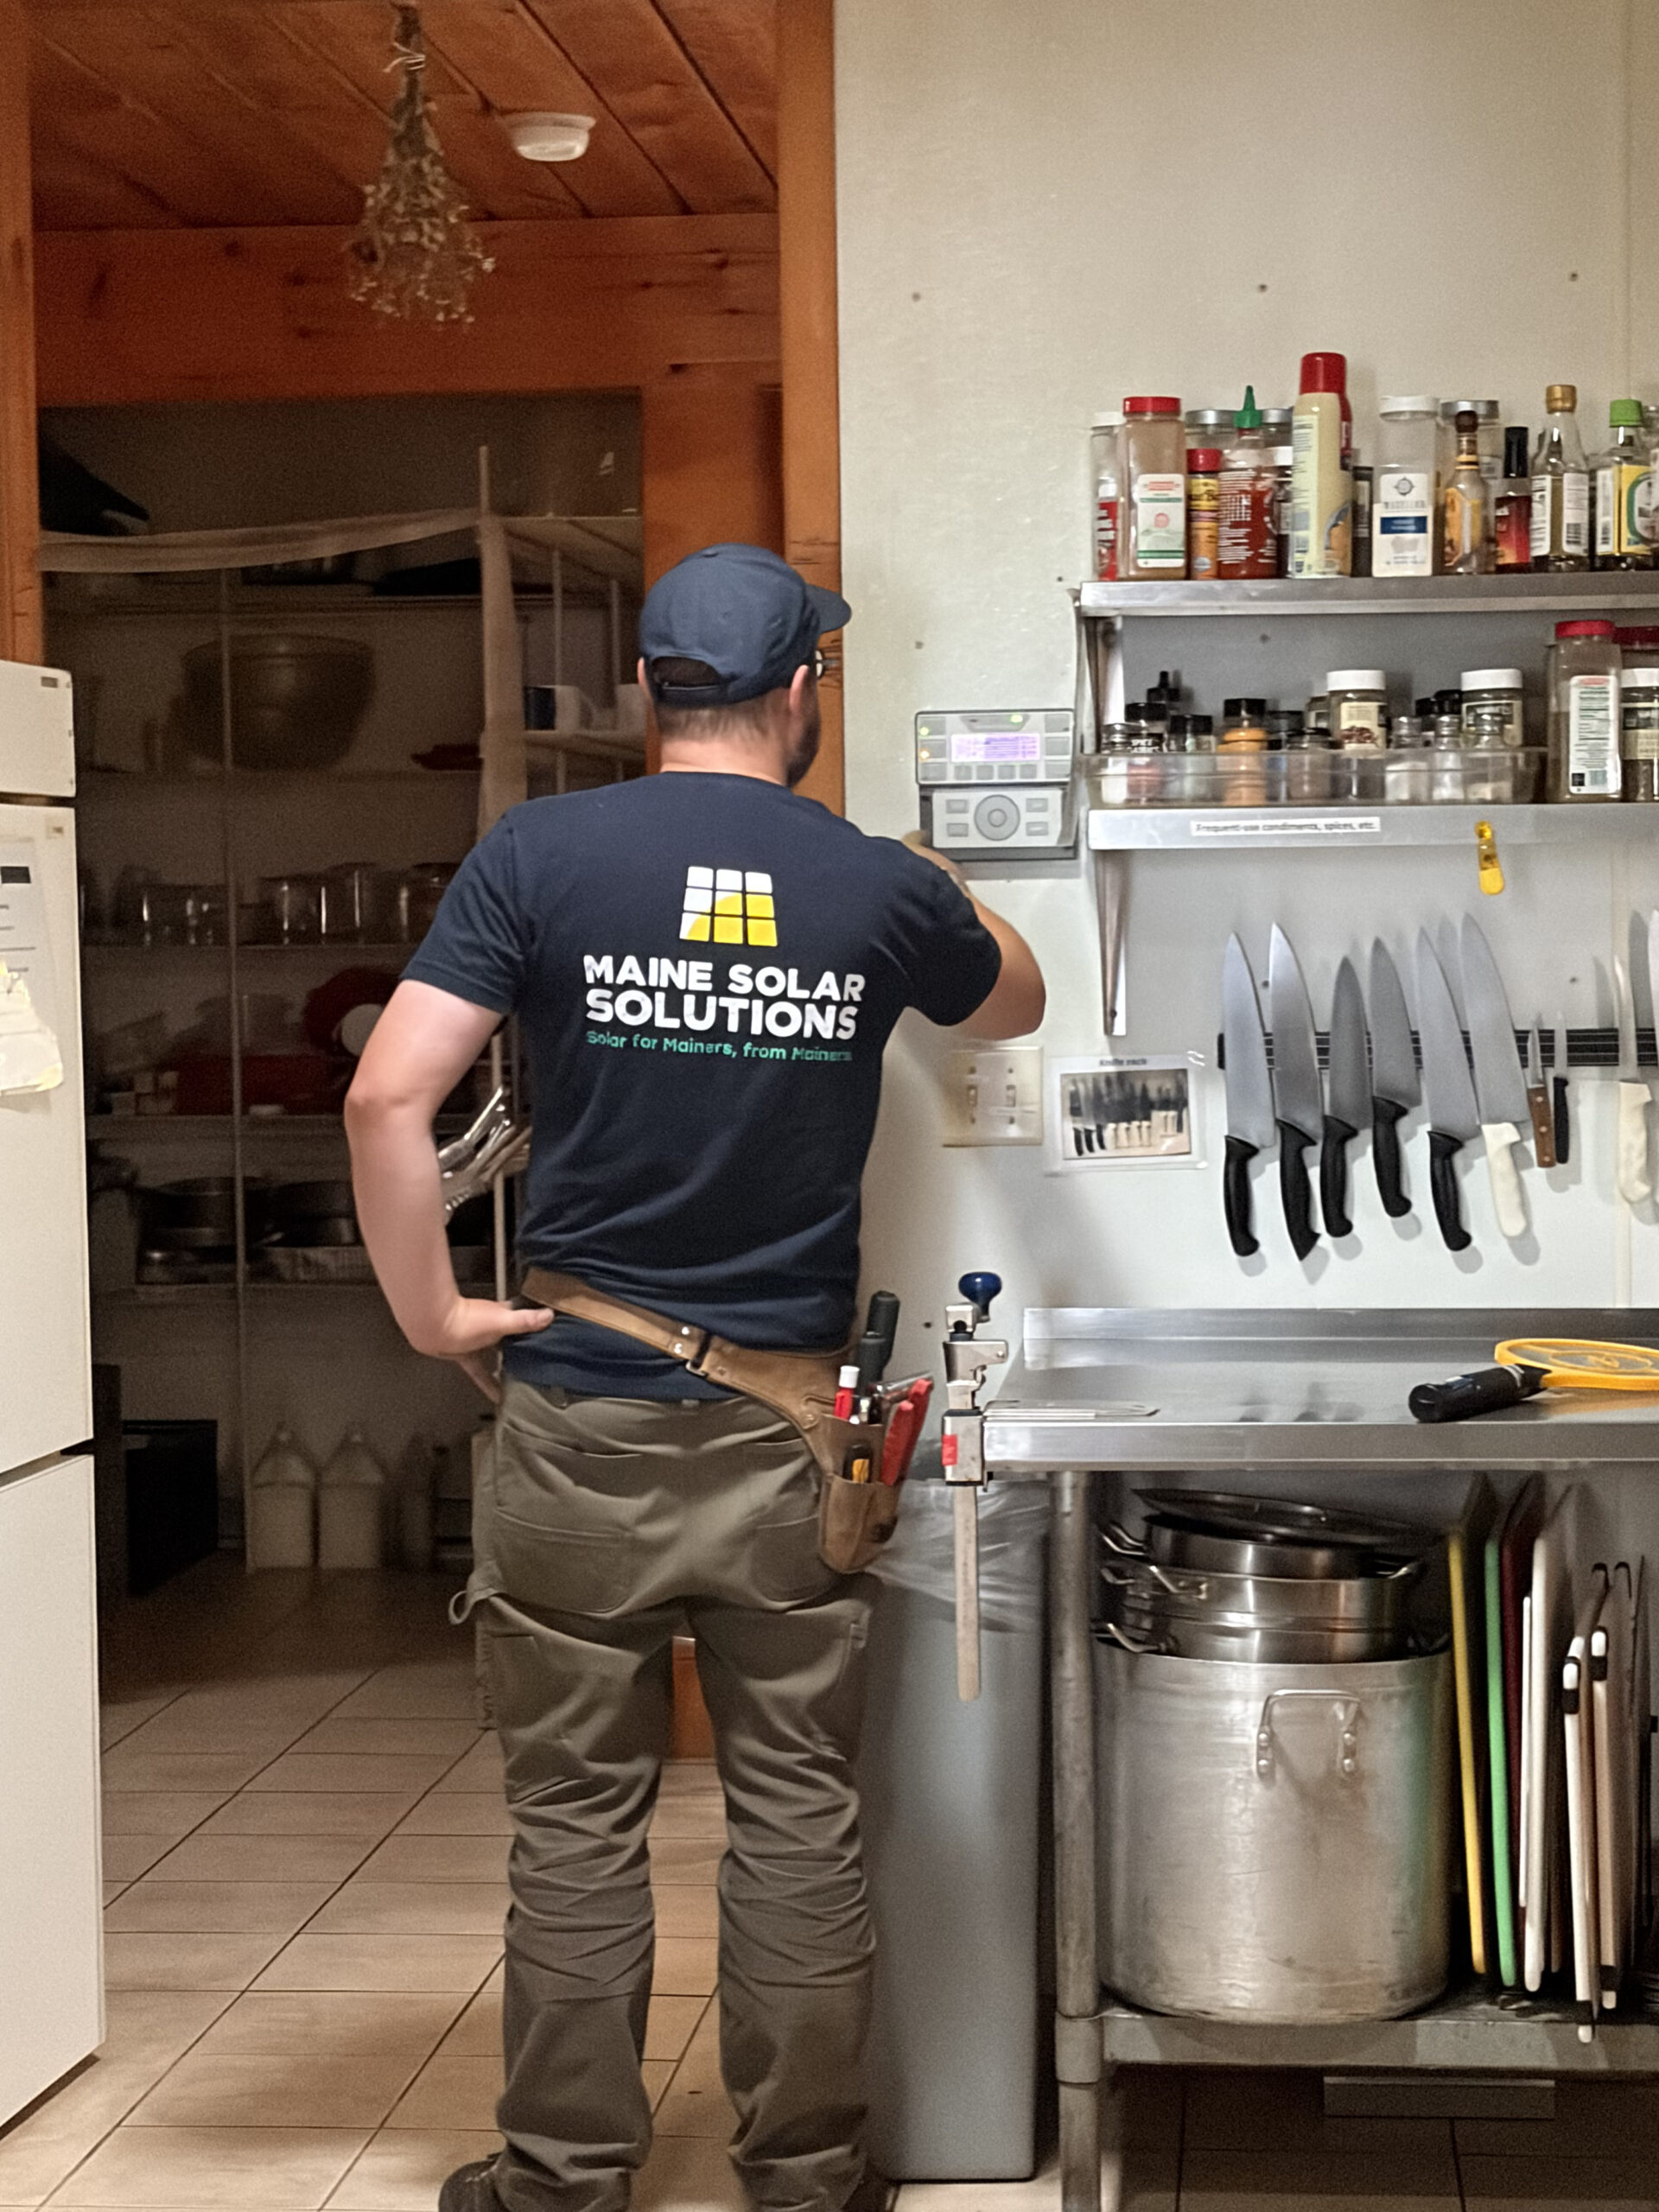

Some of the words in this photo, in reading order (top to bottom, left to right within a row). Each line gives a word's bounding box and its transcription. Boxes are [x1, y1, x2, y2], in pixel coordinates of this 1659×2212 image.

[583, 955, 713, 991] MAINE
[728, 963, 866, 1001] SOLAR
[586, 988, 859, 1040] SOLUTIONS
[586, 1030, 626, 1048] Solar
[632, 1034, 657, 1051] for
[663, 1038, 738, 1058] Mainers,
[743, 1042, 787, 1061] from
[791, 1046, 853, 1062] Mainers
